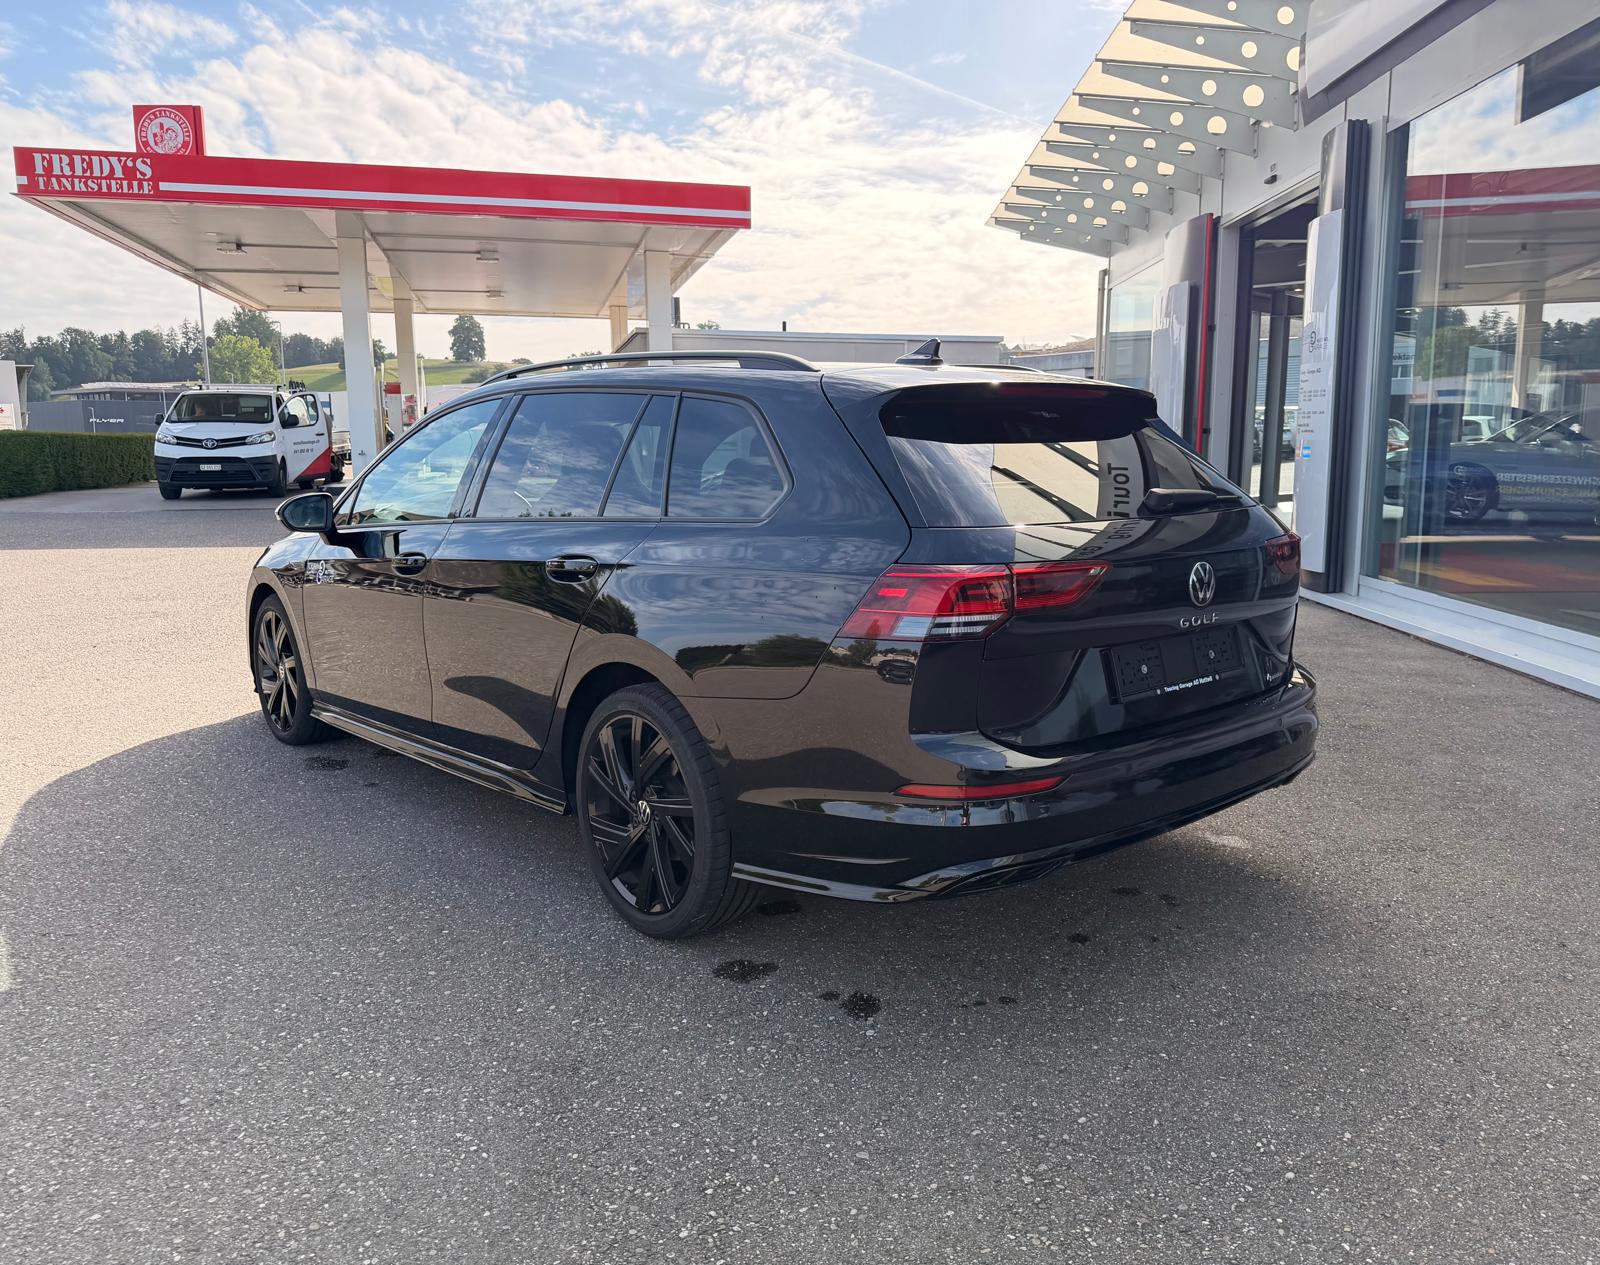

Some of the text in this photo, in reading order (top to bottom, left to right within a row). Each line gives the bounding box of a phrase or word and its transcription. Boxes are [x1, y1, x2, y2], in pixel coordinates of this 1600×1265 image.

[32, 153, 153, 179] FREDY'S
[35, 177, 154, 195] TANKSTELLE
[1180, 612, 1219, 628] GOLF
